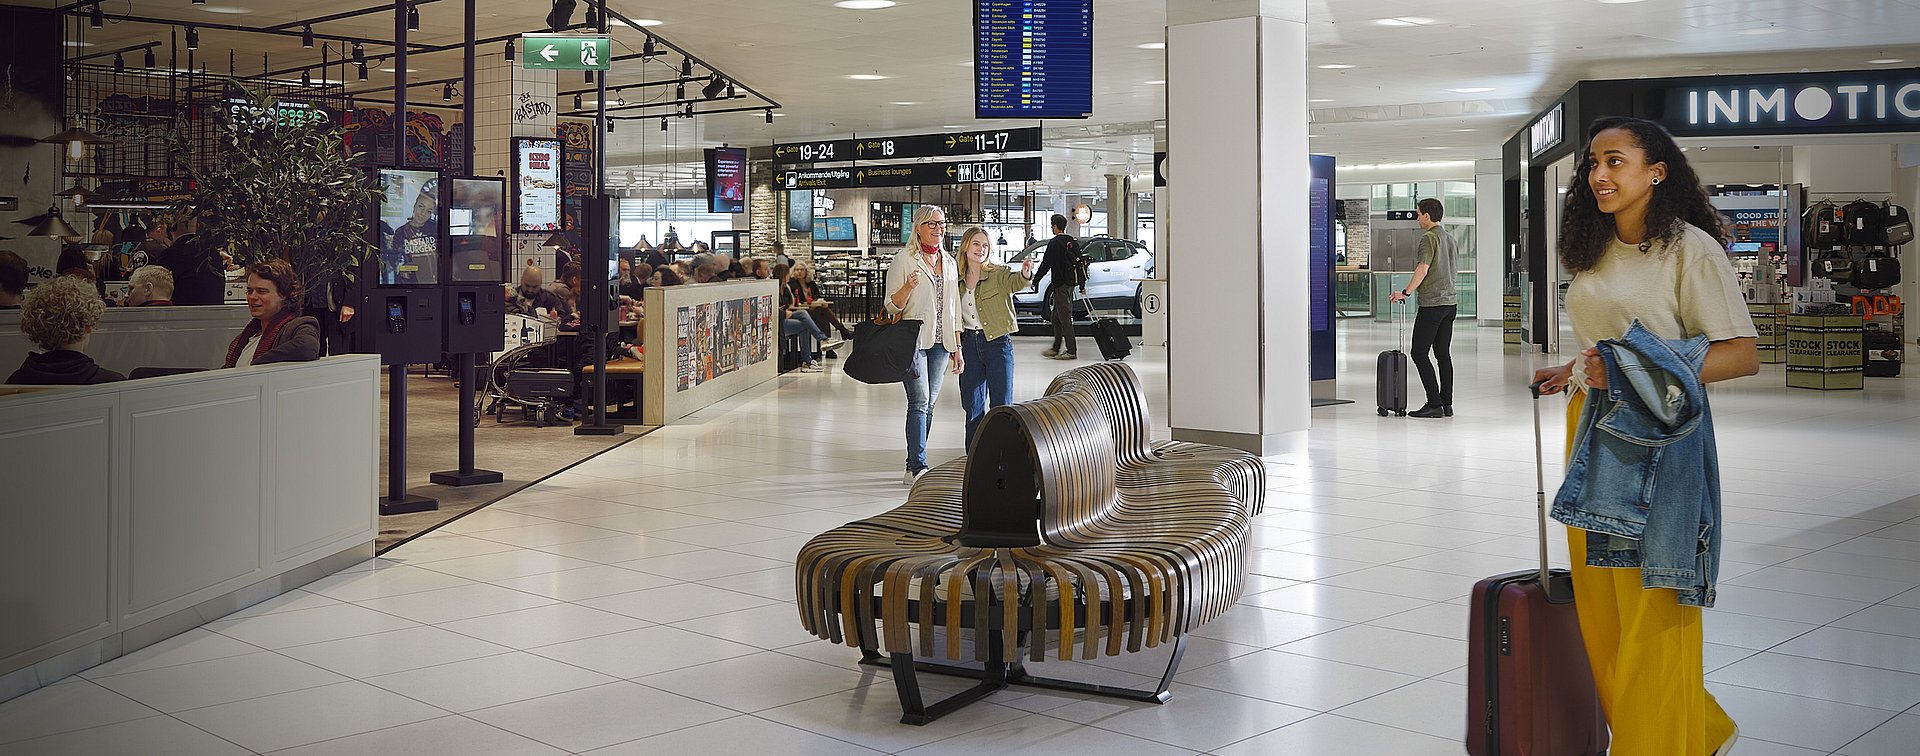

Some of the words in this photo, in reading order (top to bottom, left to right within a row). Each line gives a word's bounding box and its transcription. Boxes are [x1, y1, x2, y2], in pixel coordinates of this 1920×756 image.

[975, 133, 1009, 150] 11-17
[800, 144, 834, 160] 19-24
[881, 140, 895, 156] 18
[529, 152, 550, 161] KIDS
[404, 237, 435, 246] BASTARD
[405, 244, 436, 254] BURGERS
[1789, 339, 1822, 350] STOCK
[1826, 340, 1860, 349] STOCK
